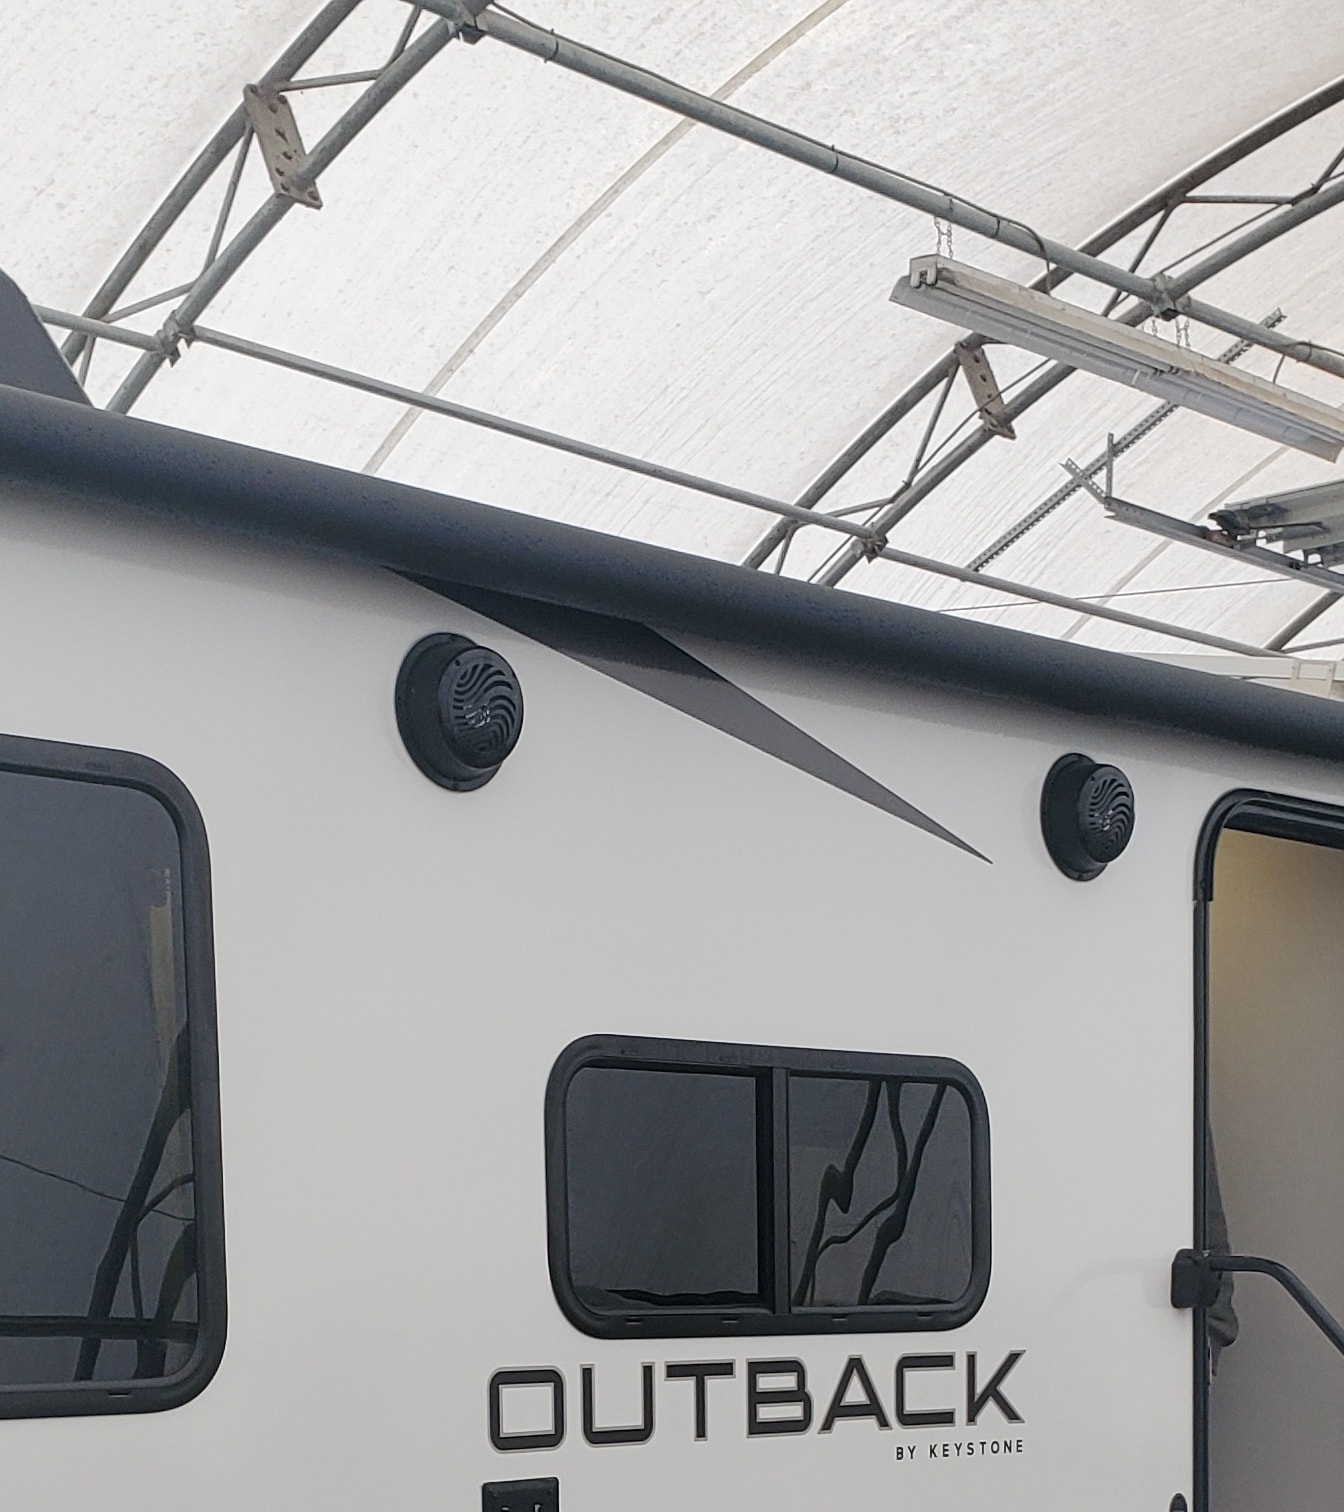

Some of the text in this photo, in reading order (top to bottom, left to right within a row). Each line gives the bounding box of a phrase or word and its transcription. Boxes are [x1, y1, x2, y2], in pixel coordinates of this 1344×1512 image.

[487, 1349, 1027, 1454] OUTBACK
[895, 1439, 1025, 1460] BY KEYSTONE
